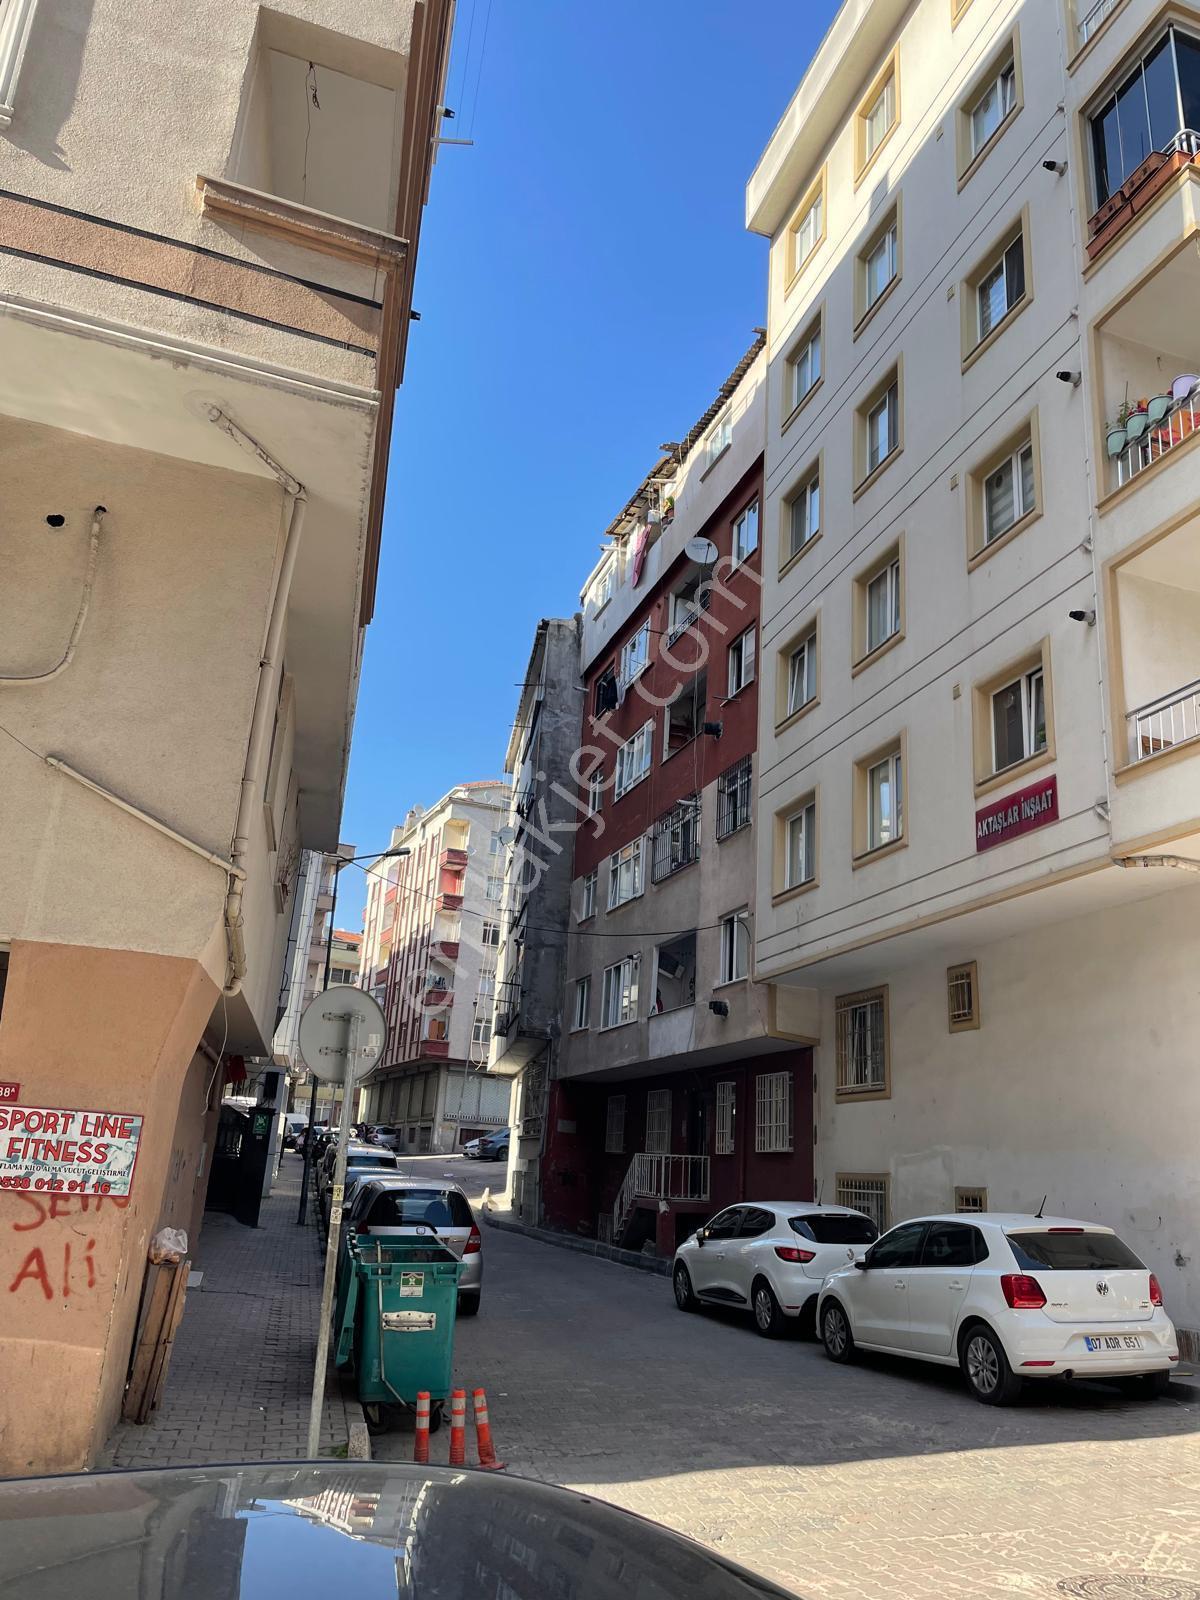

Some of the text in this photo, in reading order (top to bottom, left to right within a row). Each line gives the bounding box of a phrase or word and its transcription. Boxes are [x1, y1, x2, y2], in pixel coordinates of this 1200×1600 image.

[977, 789, 1053, 838] AKTAŞLAR İNŞAAT
[0, 1108, 134, 1139] SPORT LINE
[6, 1138, 110, 1165] FITNESS
[0, 1175, 112, 1194] 538 012 91 16
[1090, 1335, 1141, 1350] 07 ADR 651
